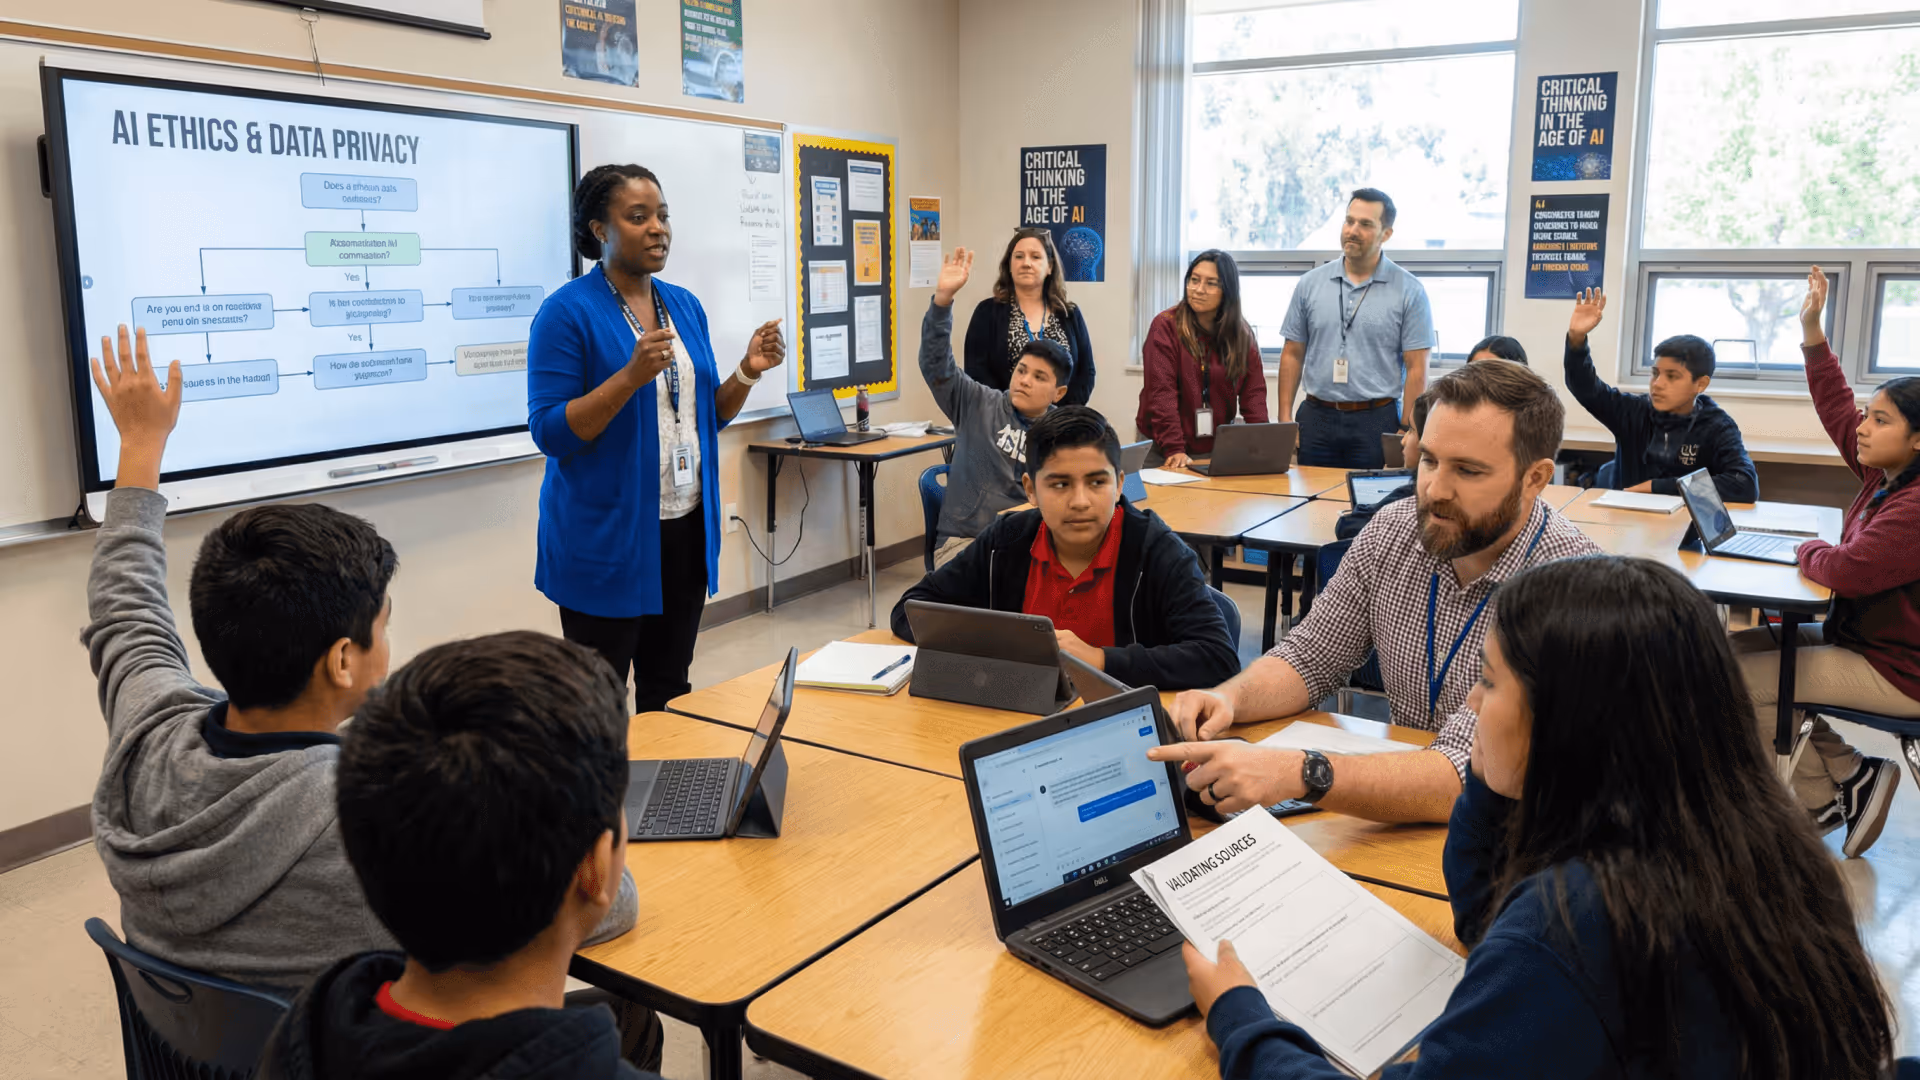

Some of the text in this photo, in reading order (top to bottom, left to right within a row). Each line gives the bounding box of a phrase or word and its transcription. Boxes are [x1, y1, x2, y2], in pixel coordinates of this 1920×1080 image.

[1541, 77, 1604, 97] CRITICAL
[1541, 94, 1608, 113] THINKING
[1540, 112, 1585, 130] IN THE
[112, 110, 419, 165] AI ETHICS & DATA PRIVACY
[1538, 128, 1604, 147] AGE OF AI
[1025, 150, 1082, 169] CRITICAL
[323, 180, 344, 190] Does
[1025, 168, 1085, 187] THINKING
[1025, 187, 1066, 206] IN THE
[1025, 205, 1084, 224] AGE OF AI
[344, 272, 360, 282] Yes
[147, 304, 163, 313] Are
[165, 304, 182, 315] you
[212, 302, 223, 311] on
[347, 333, 363, 342] Yes
[217, 376, 225, 385] in
[227, 375, 241, 385] the
[1165, 833, 1257, 891] VALIDATING SOURCES
